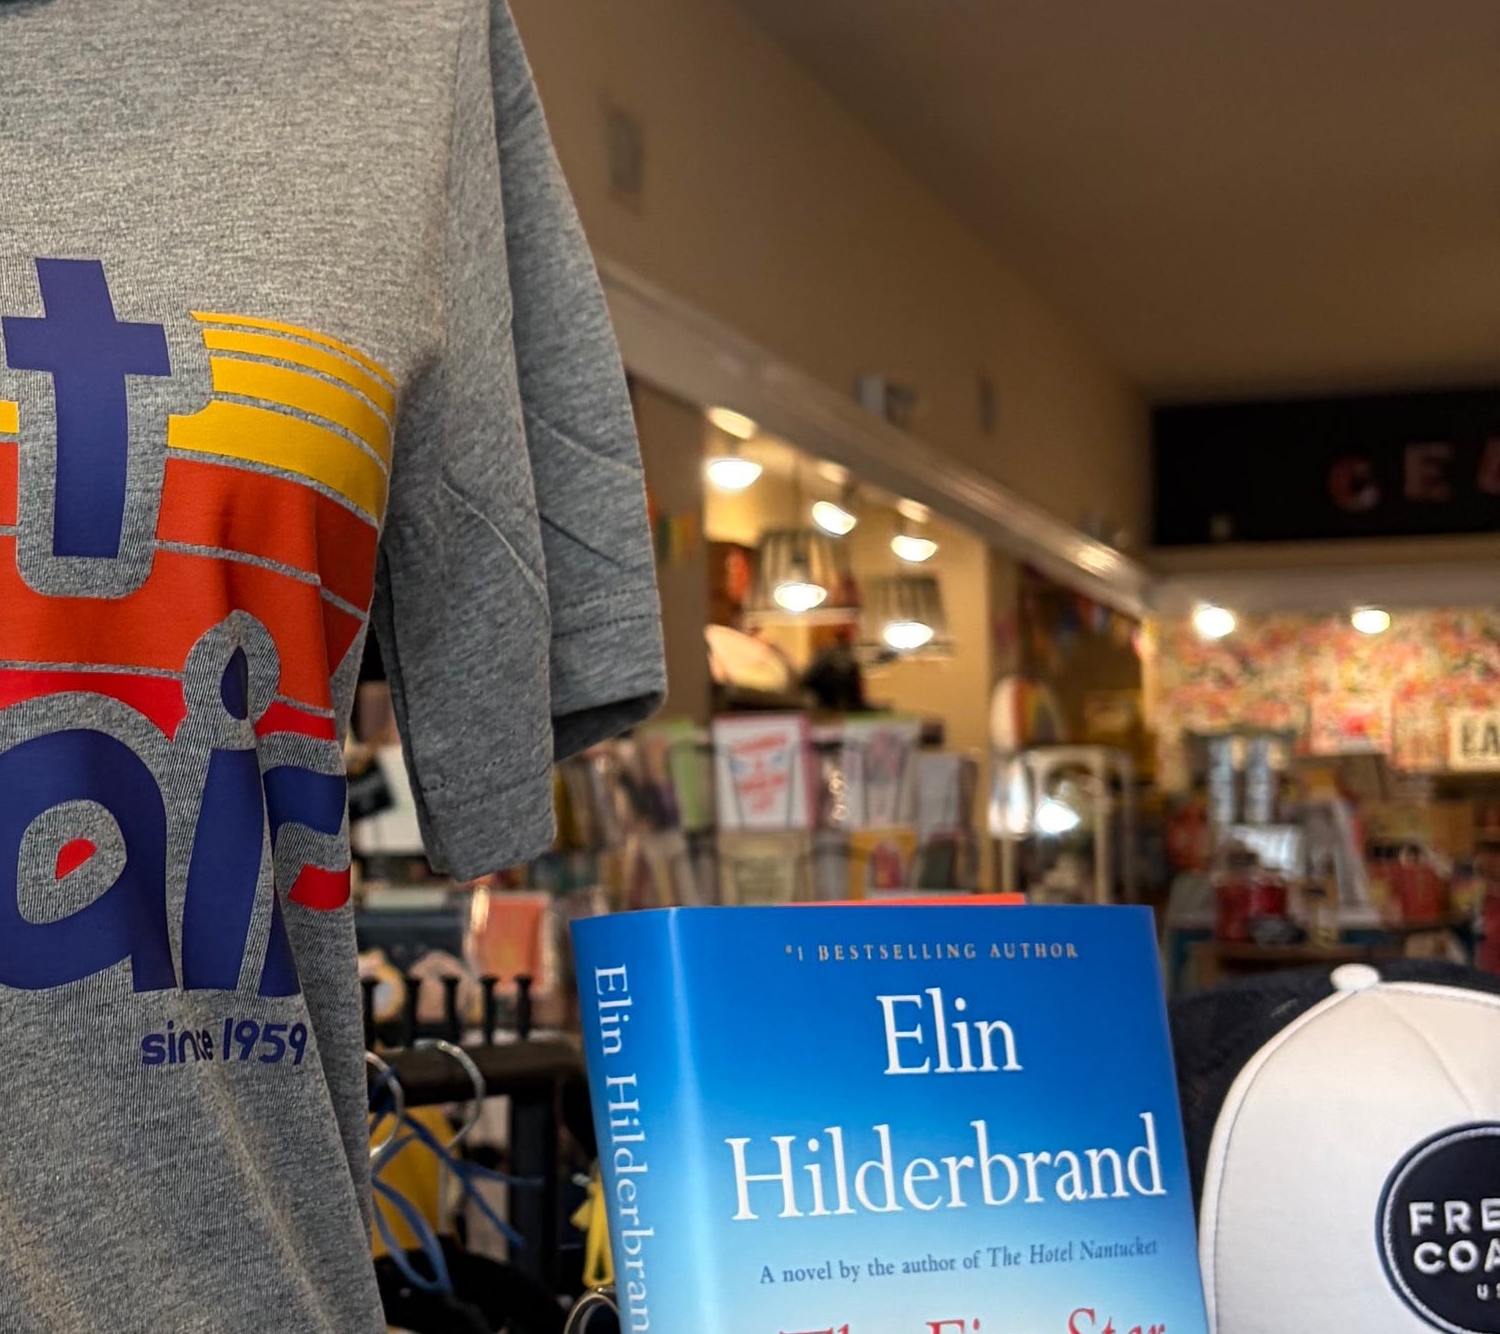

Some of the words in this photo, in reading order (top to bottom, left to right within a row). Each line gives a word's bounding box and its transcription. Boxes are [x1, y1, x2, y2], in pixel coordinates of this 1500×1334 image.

[818, 943, 977, 961] BESTSELLING
[989, 942, 1079, 959] AUTHOR
[141, 1020, 214, 1066] sine
[222, 1017, 308, 1066] 1959
[594, 964, 634, 1057] Elin
[876, 986, 1023, 1075] Elin
[725, 1111, 1168, 1221] Hilderbrand
[759, 1265, 775, 1284] A
[782, 1261, 833, 1283] novel
[839, 1260, 861, 1283] by
[868, 1256, 895, 1277] the
[902, 1253, 957, 1274] author
[962, 1250, 982, 1270] of
[987, 1246, 1021, 1268] The
[1029, 1241, 1074, 1265] Hotel
[1080, 1235, 1158, 1259] Nantucket
